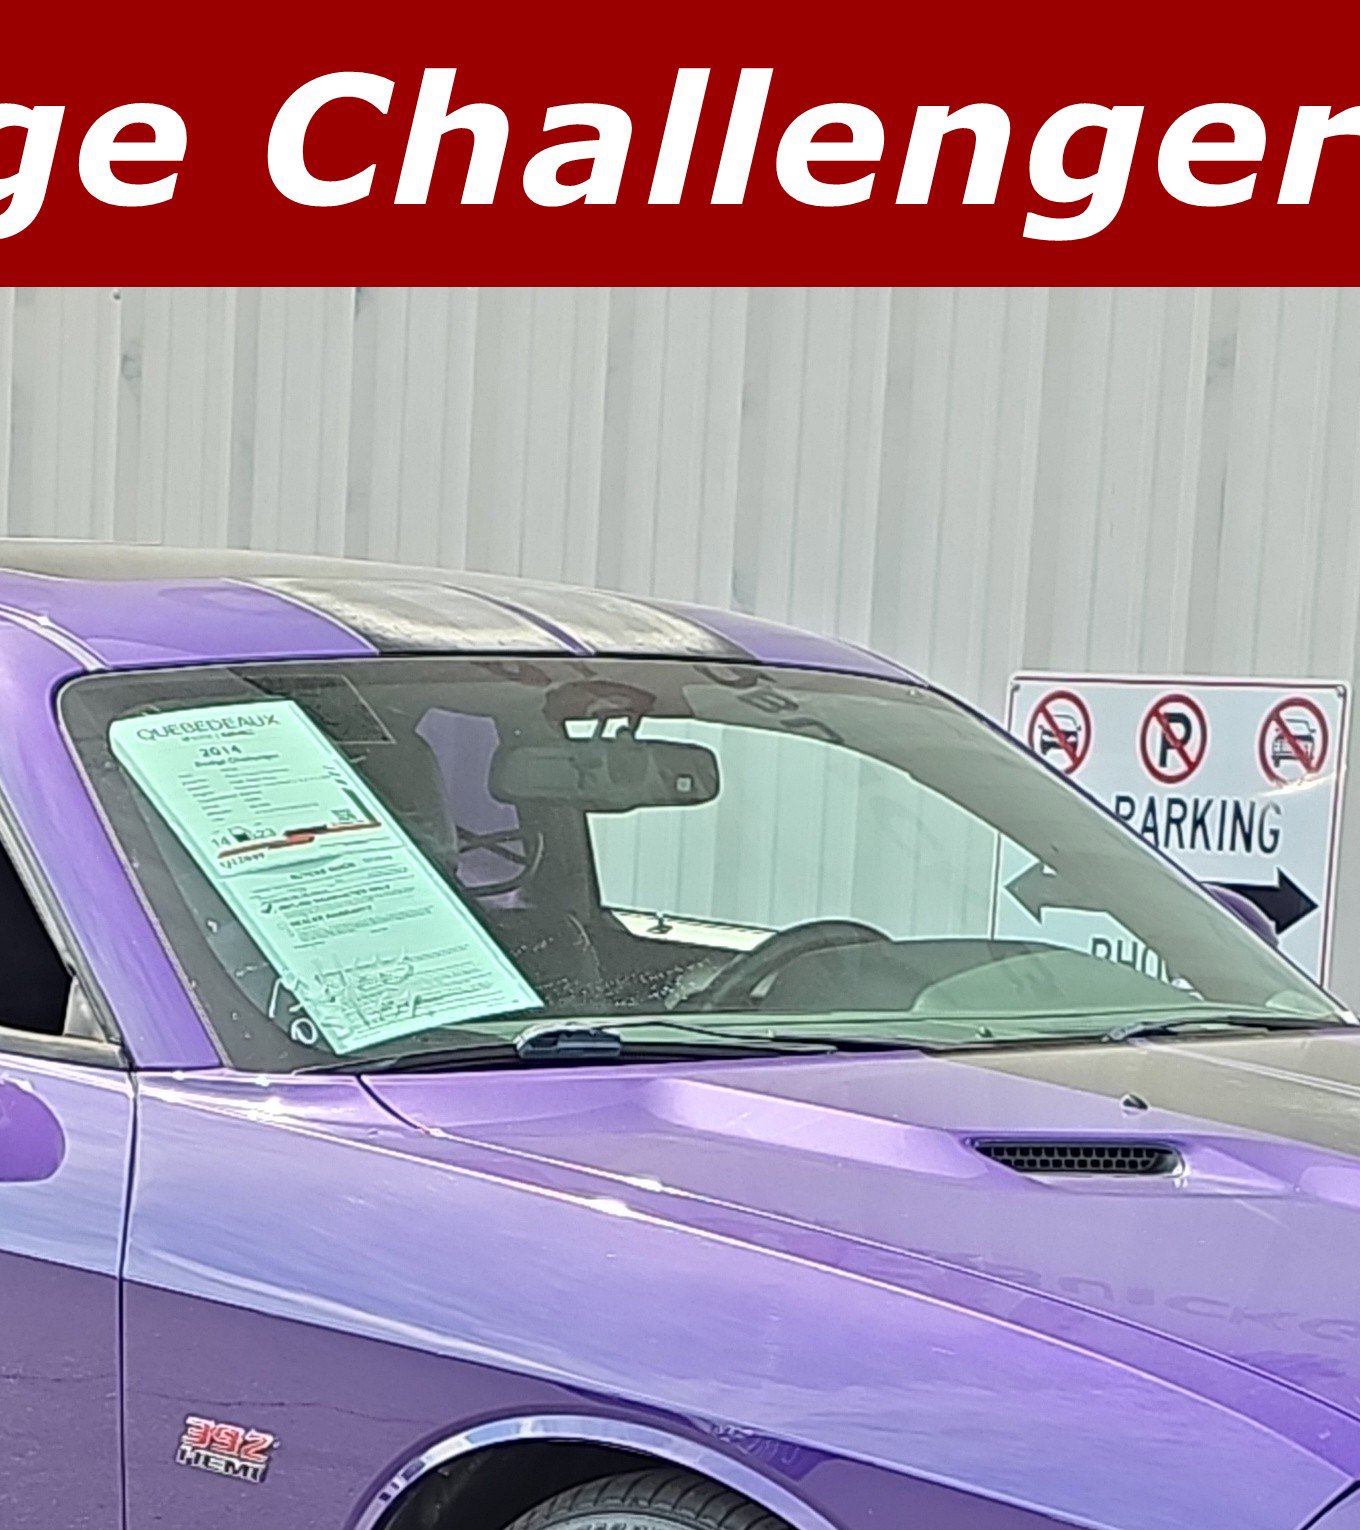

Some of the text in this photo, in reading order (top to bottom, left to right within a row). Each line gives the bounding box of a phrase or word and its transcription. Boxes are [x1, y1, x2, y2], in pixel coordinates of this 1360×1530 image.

[136, 713, 281, 741] QUEBEDEAUX
[198, 744, 242, 758] 2014
[1115, 795, 1282, 854] PARKING
[182, 1416, 275, 1464] 392
[175, 1443, 267, 1484] HEMI
